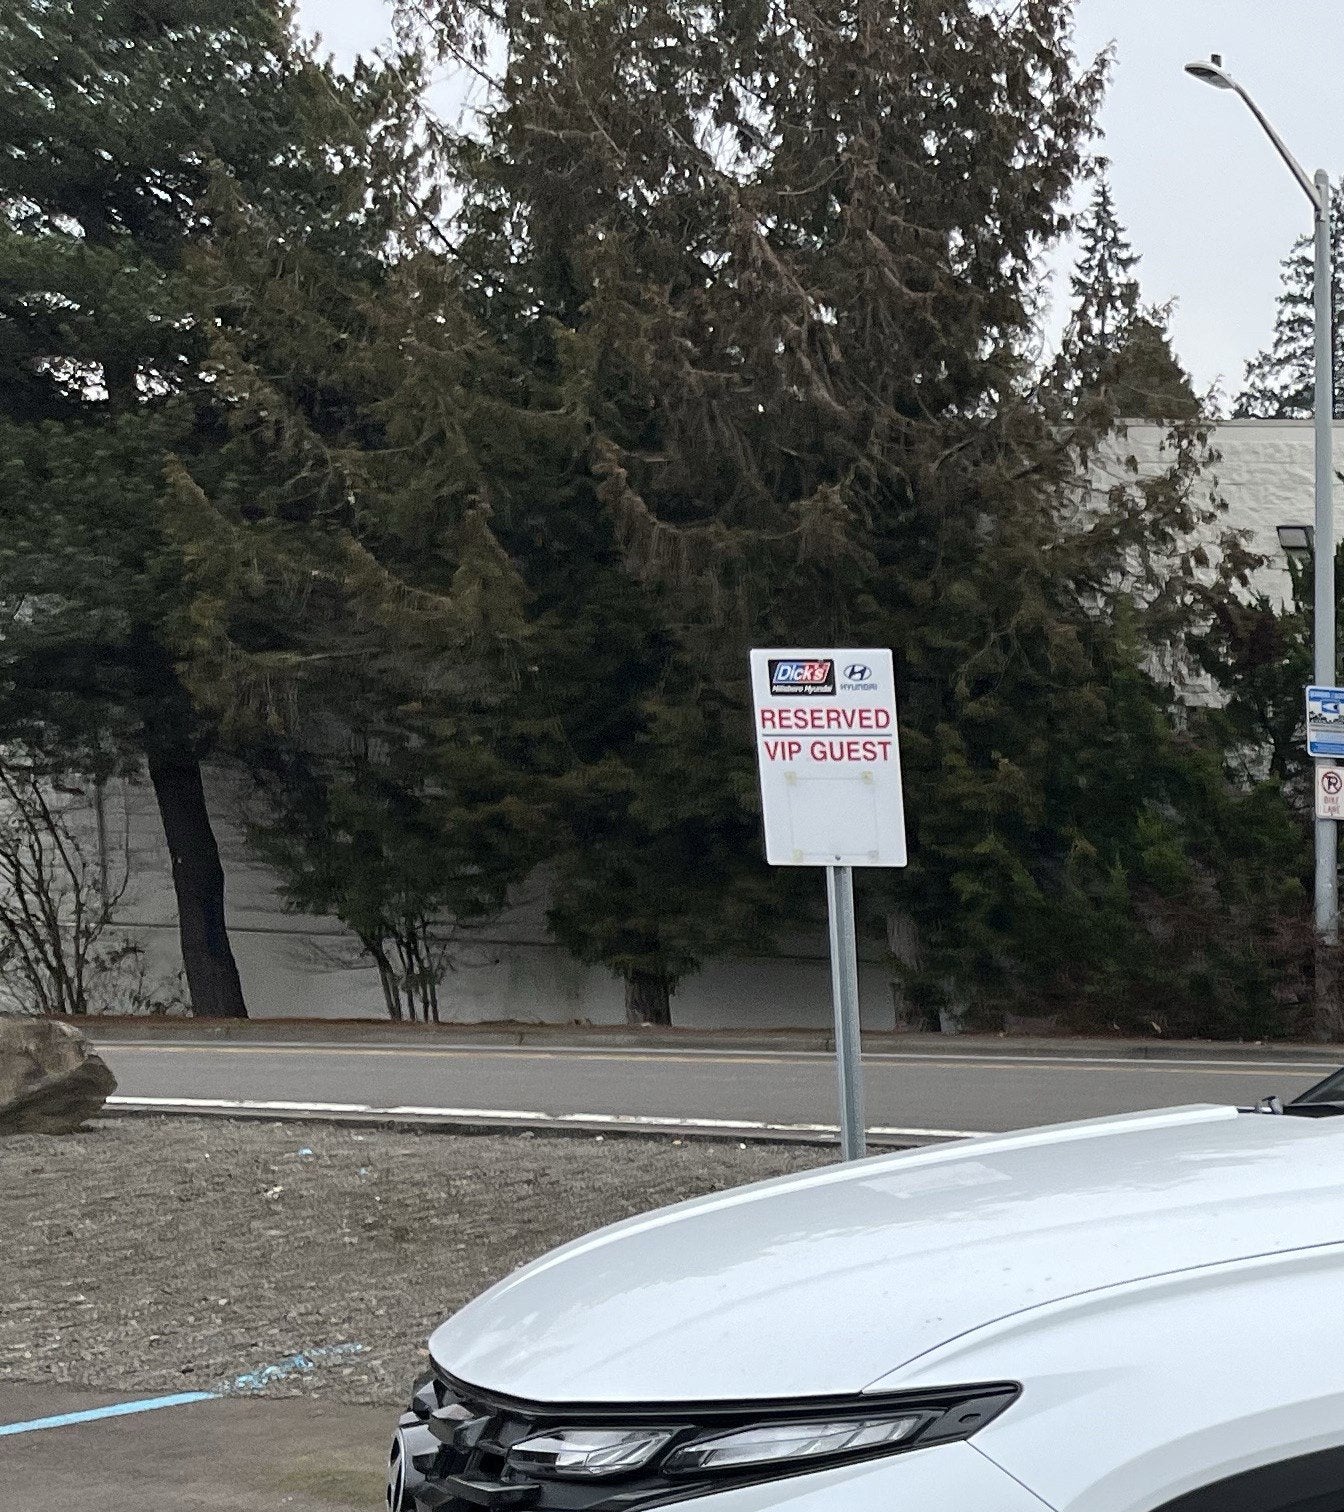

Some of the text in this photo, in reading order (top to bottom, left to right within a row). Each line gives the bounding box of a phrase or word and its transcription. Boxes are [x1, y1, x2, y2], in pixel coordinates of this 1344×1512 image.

[760, 708, 891, 729] RESERVED
[764, 740, 892, 762] VIP GUEST
